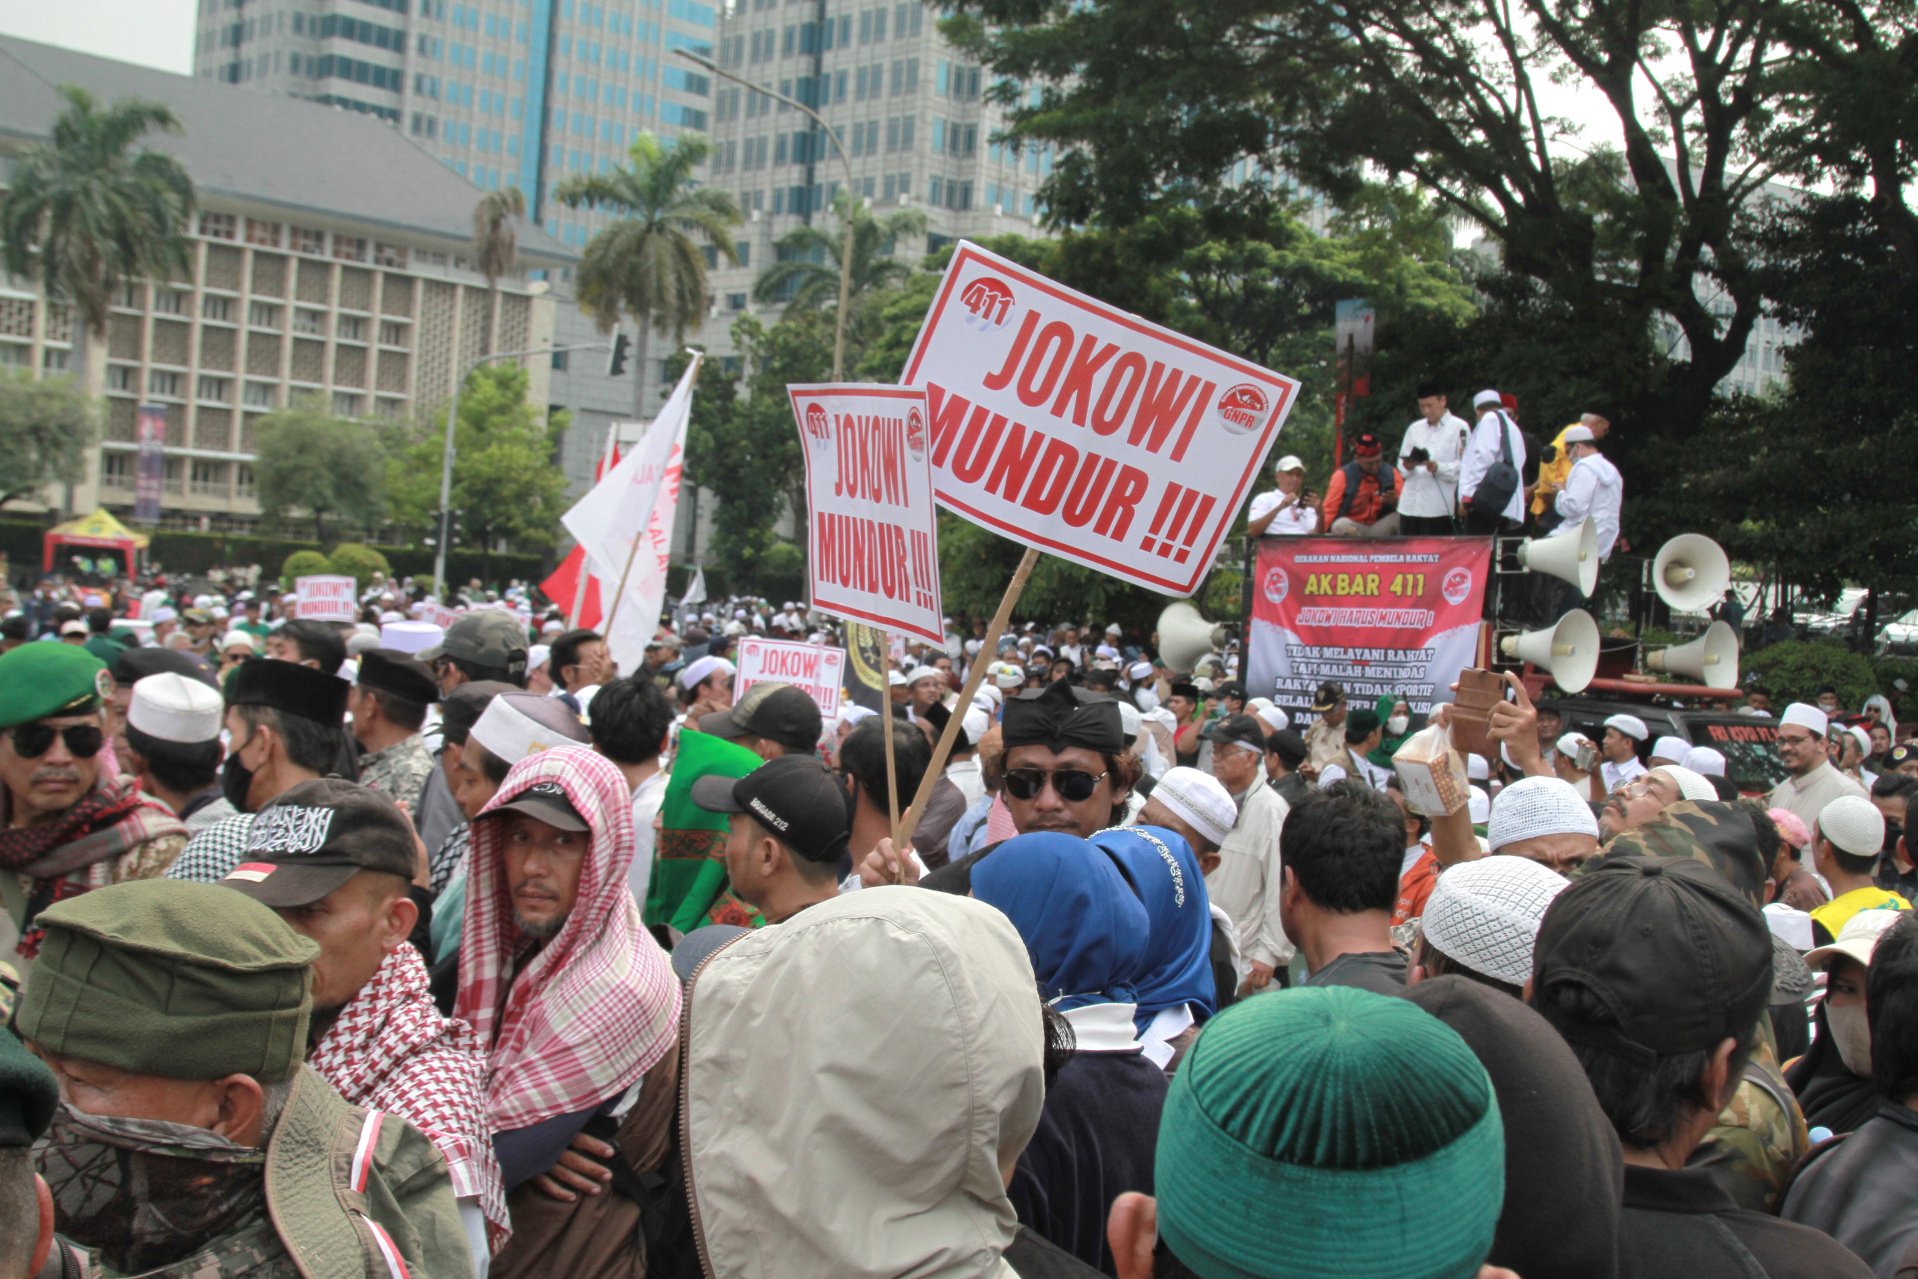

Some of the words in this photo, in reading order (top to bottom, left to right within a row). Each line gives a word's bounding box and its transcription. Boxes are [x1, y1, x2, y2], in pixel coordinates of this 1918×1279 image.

[962, 283, 1015, 326] 411
[982, 309, 1217, 463] JOKOWI
[808, 412, 830, 440] 411
[1223, 405, 1256, 430] GNPR
[834, 413, 909, 508] JOKOWI
[926, 380, 1150, 543] MUNDUR
[1139, 481, 1218, 565] !!!
[817, 511, 911, 603] MUNDUR
[908, 531, 935, 612] !!!
[1405, 554, 1440, 562] RAKYAT
[1304, 573, 1380, 596] AKBAR
[1389, 573, 1425, 596] 411
[1296, 607, 1339, 626] JOKOWI
[1337, 608, 1376, 627] HARUS
[1375, 609, 1427, 628] MUNDUR
[1286, 645, 1321, 659] TIDAK
[1321, 646, 1386, 661] MELAYANI
[1319, 662, 1364, 677] MALAH
[1275, 677, 1320, 691] RAKYA
[1353, 683, 1394, 696] TIDAK
[750, 797, 776, 822] BRIGADE
[773, 817, 789, 832] 212
